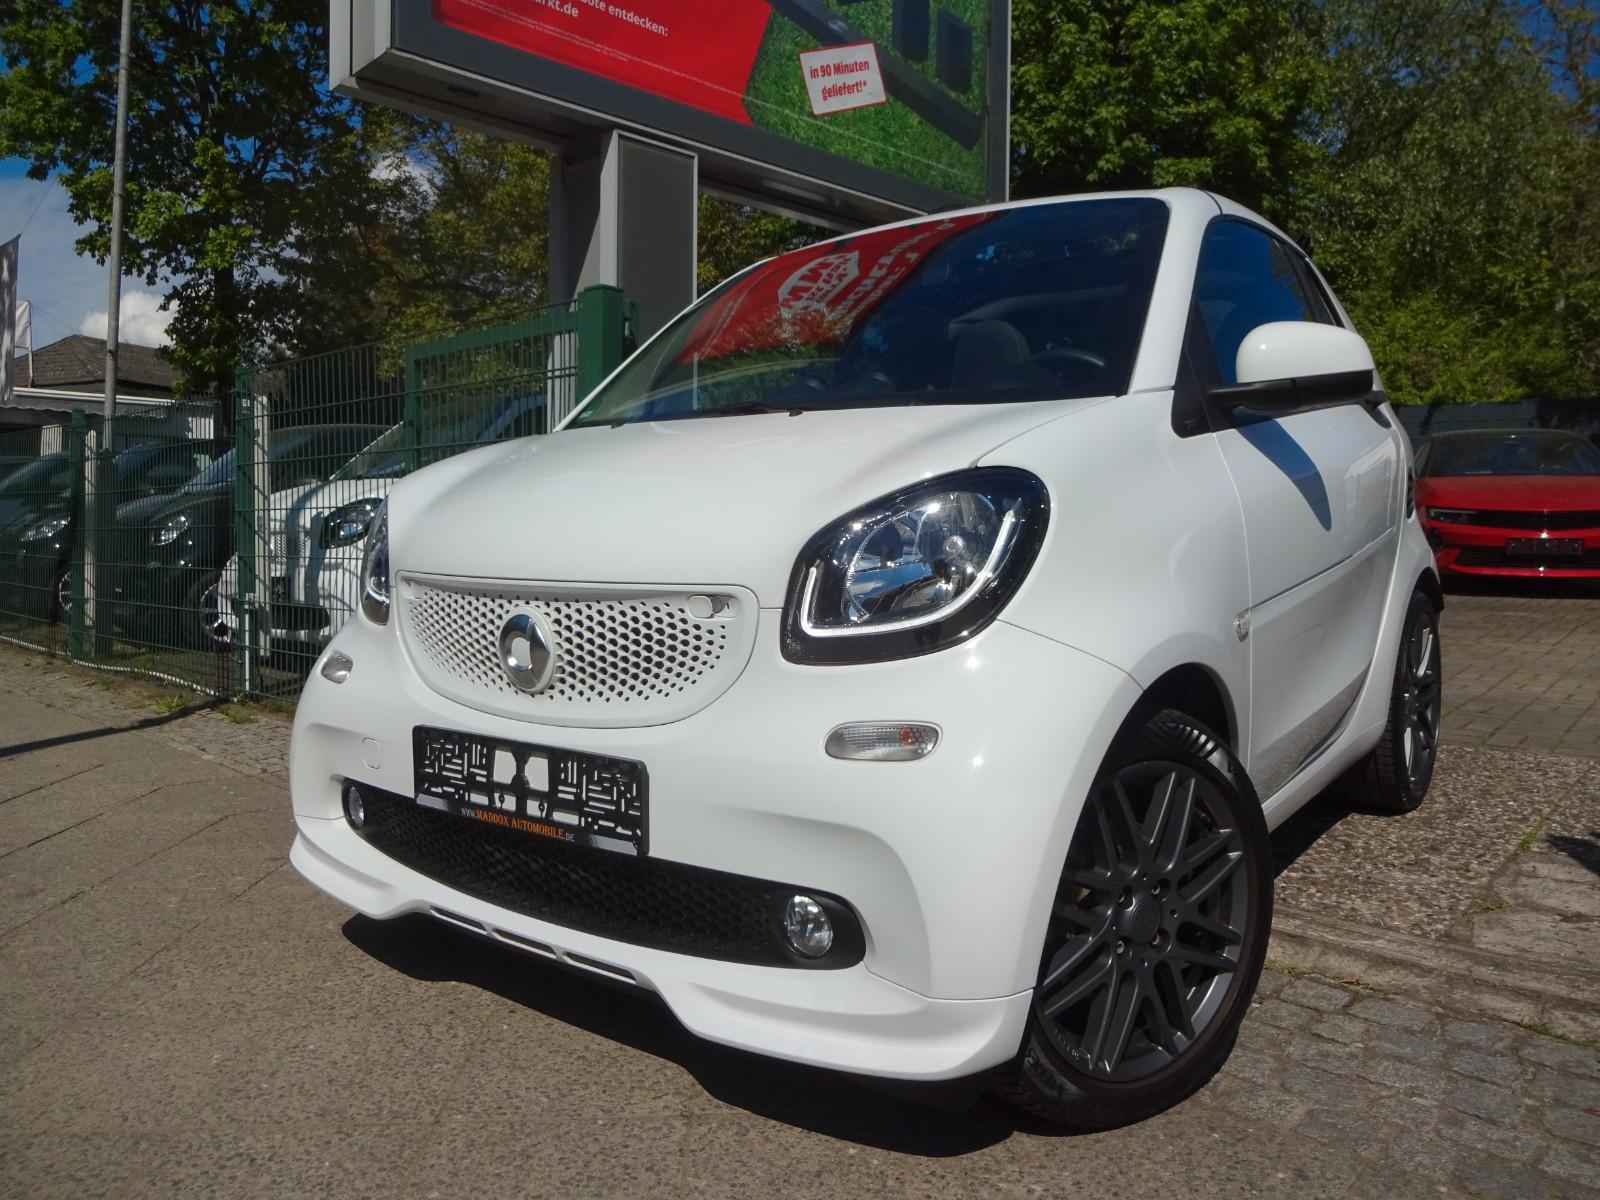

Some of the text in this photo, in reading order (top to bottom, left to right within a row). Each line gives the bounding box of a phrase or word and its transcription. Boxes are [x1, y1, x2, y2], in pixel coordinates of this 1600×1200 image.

[608, 5, 668, 37] entdecken:
[809, 60, 870, 79] in 90 Minuten
